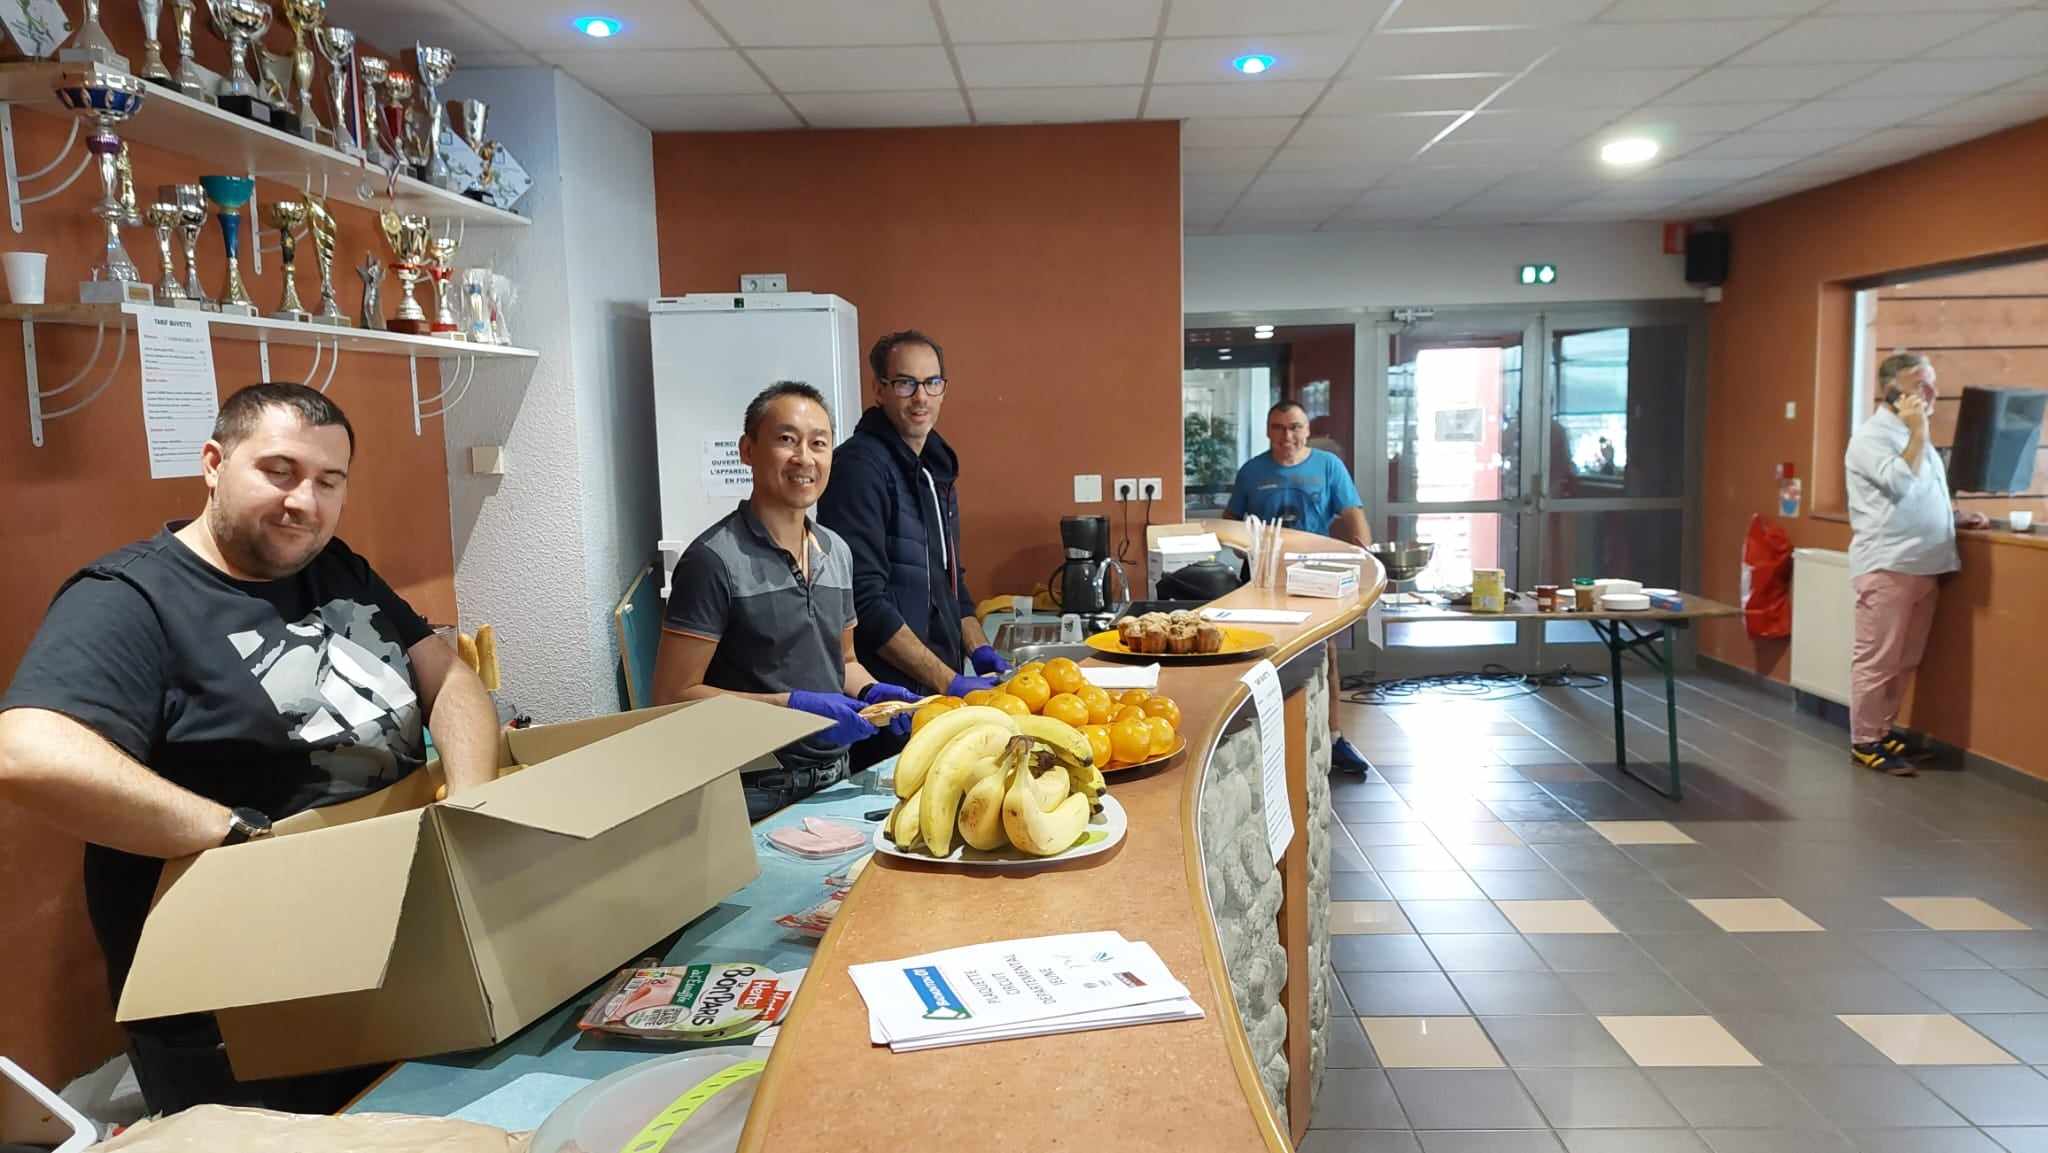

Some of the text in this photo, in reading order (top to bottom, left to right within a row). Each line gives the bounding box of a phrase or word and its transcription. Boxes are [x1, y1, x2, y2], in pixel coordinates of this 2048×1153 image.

[964, 968, 1000, 1004] PLAQUETTE
[991, 971, 1020, 995] CIRCUIT
[1039, 967, 1066, 986] JEUNE
[744, 980, 772, 1006] Herta
